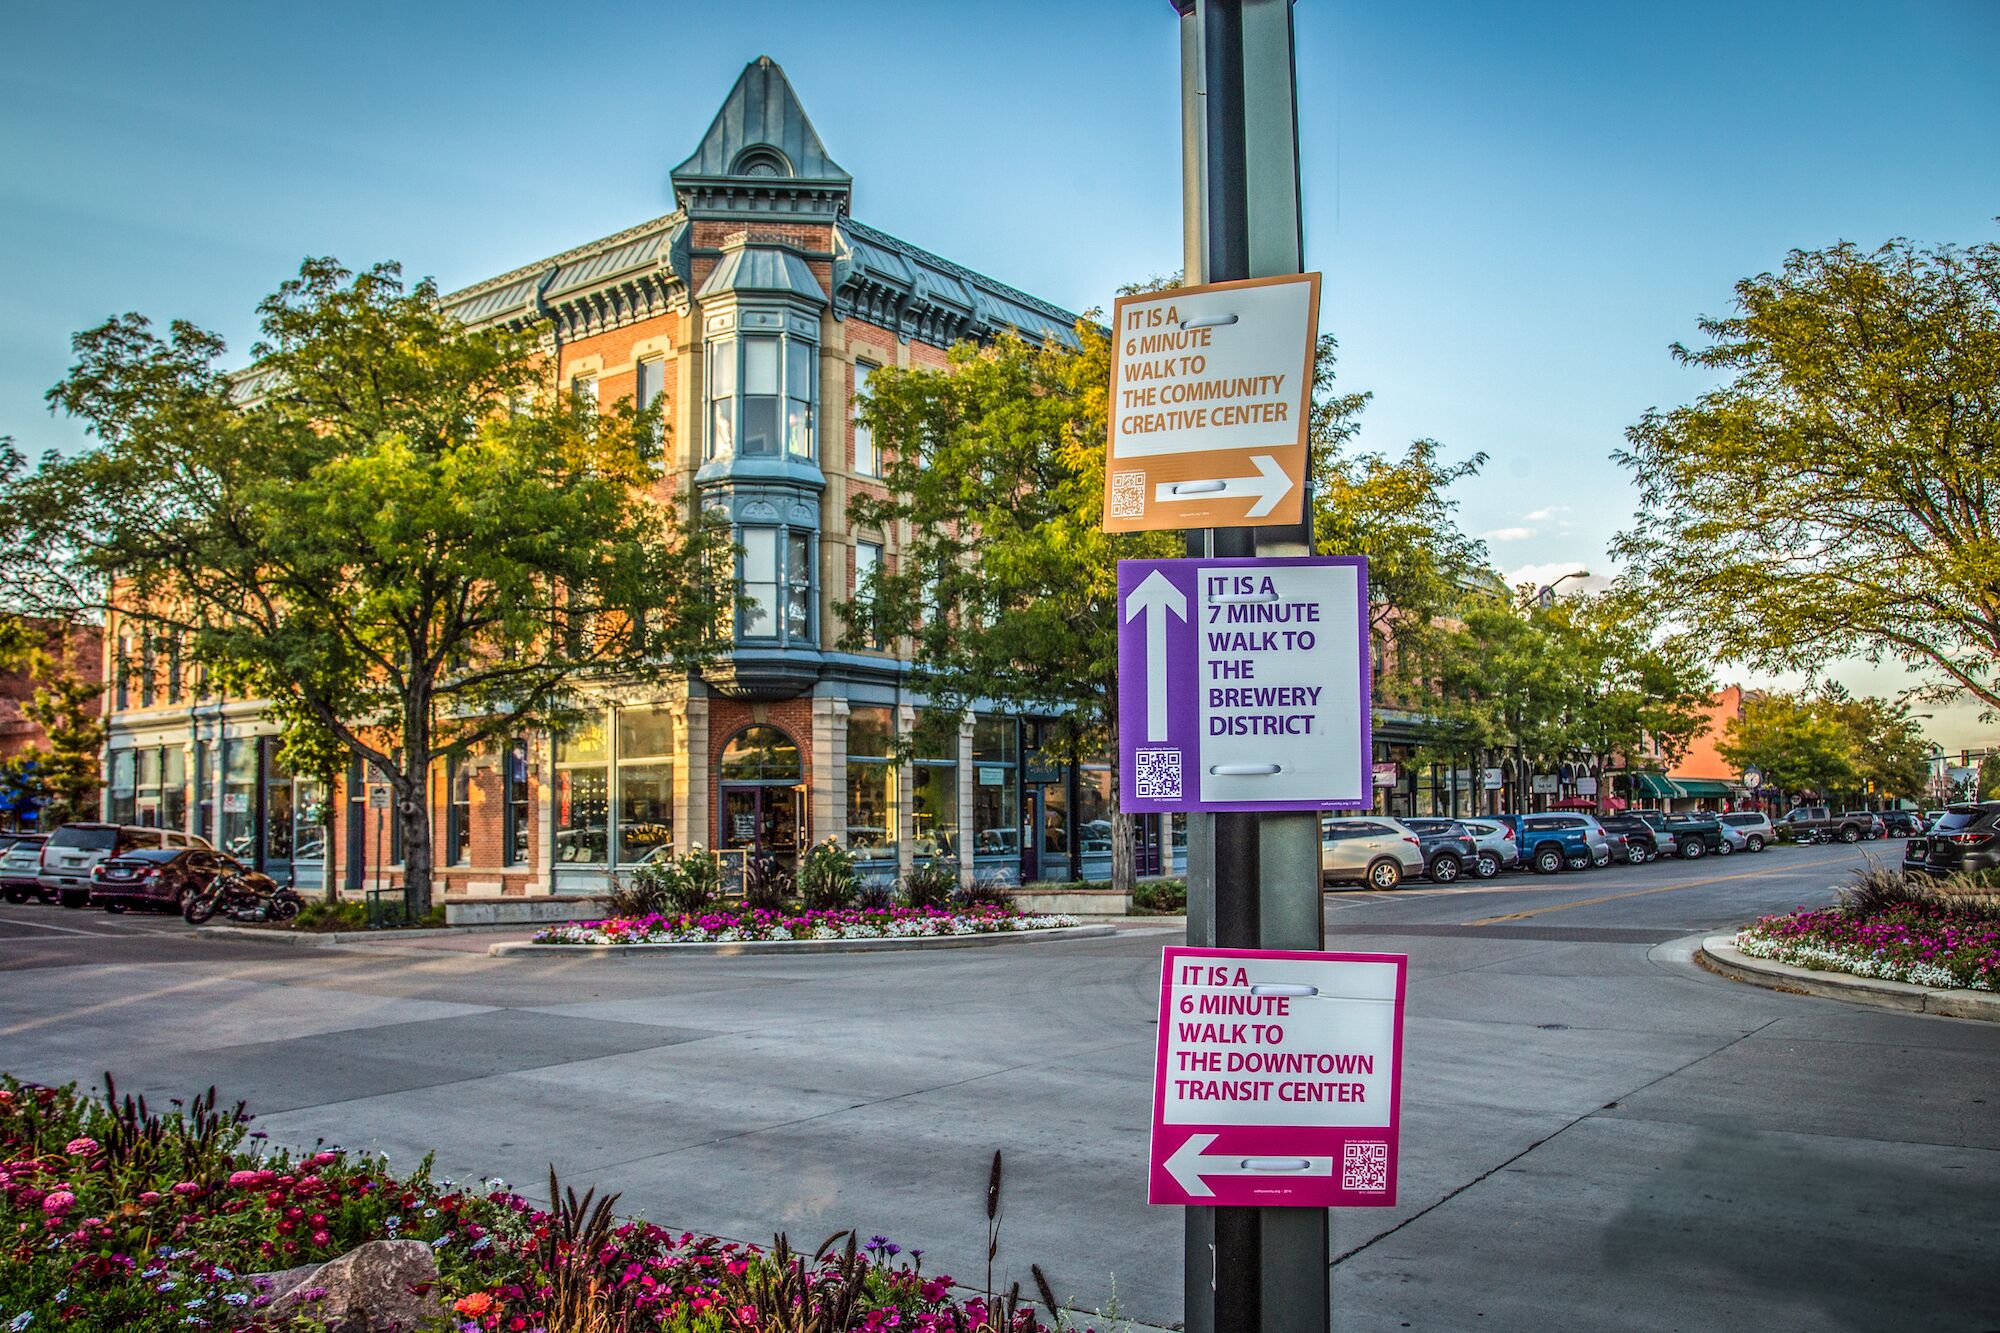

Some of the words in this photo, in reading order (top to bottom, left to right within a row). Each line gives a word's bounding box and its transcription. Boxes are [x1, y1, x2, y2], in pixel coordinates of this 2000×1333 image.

[1128, 310, 1144, 330] IT
[1147, 307, 1163, 328] IS
[1166, 305, 1180, 325] A
[1125, 338, 1136, 356] 6
[1140, 327, 1212, 355] MINUTE
[1124, 359, 1176, 383] WALK
[1180, 355, 1206, 375] TO
[1123, 387, 1156, 409] THE
[1159, 374, 1286, 404] COMMUNITY
[1121, 408, 1207, 435] CREATIVE
[1210, 401, 1288, 427] CENTER
[1208, 576, 1229, 596] IT
[1234, 576, 1254, 595] IS
[1260, 576, 1276, 595] A
[1208, 605, 1221, 624] 7
[1227, 603, 1320, 624] MINUTE
[1208, 631, 1278, 652] WALK
[1282, 631, 1316, 651] TO
[1208, 660, 1254, 680] THE
[1209, 687, 1322, 708] BREWERY
[1209, 715, 1315, 736] DISTRICT
[1182, 965, 1204, 986] IT
[1208, 966, 1228, 987] IS
[1232, 967, 1249, 987] A
[1180, 995, 1194, 1014] 6
[1199, 994, 1289, 1016] MINUTE
[1178, 1022, 1248, 1044] WALK
[1252, 1024, 1284, 1044] TO
[1176, 1051, 1222, 1072] THE
[1227, 1052, 1374, 1074] DOWNTOWN
[1175, 1080, 1274, 1101] TRANSIT
[1278, 1082, 1365, 1102] CENTER
